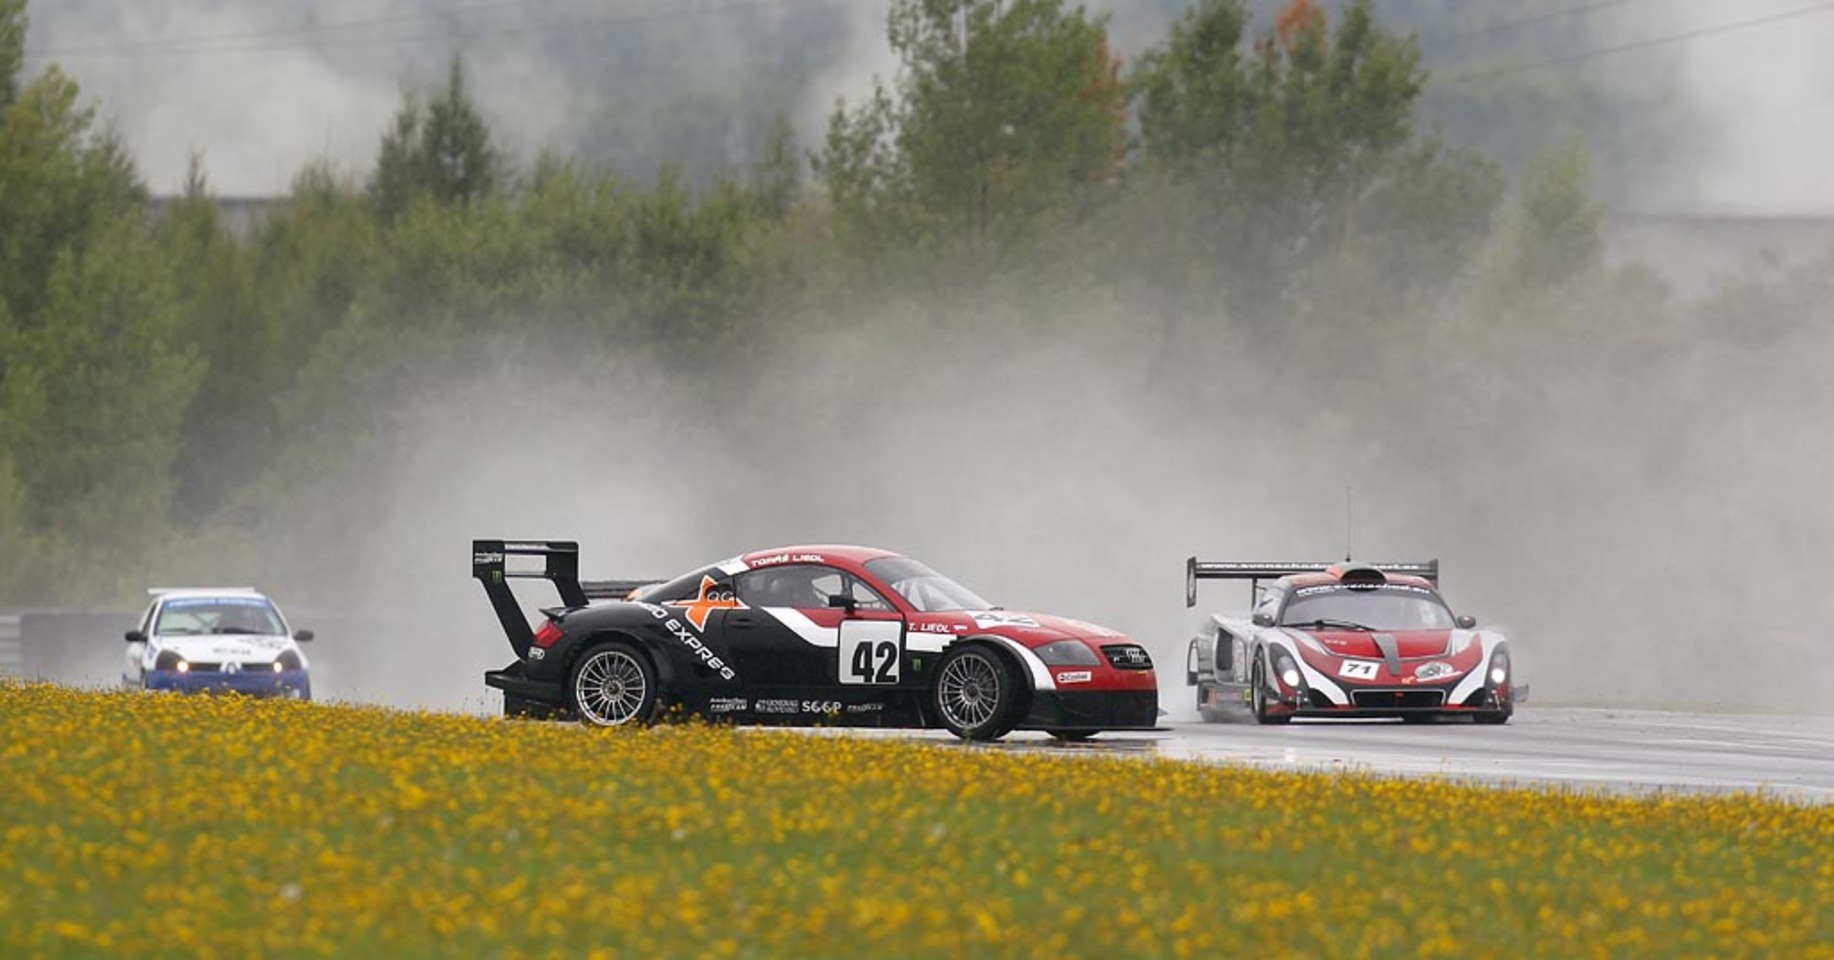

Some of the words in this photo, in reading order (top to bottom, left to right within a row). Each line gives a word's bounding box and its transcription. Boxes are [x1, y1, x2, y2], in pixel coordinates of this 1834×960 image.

[921, 623, 950, 633] LIEDL
[852, 641, 897, 683] 42
[1346, 663, 1372, 674] 71
